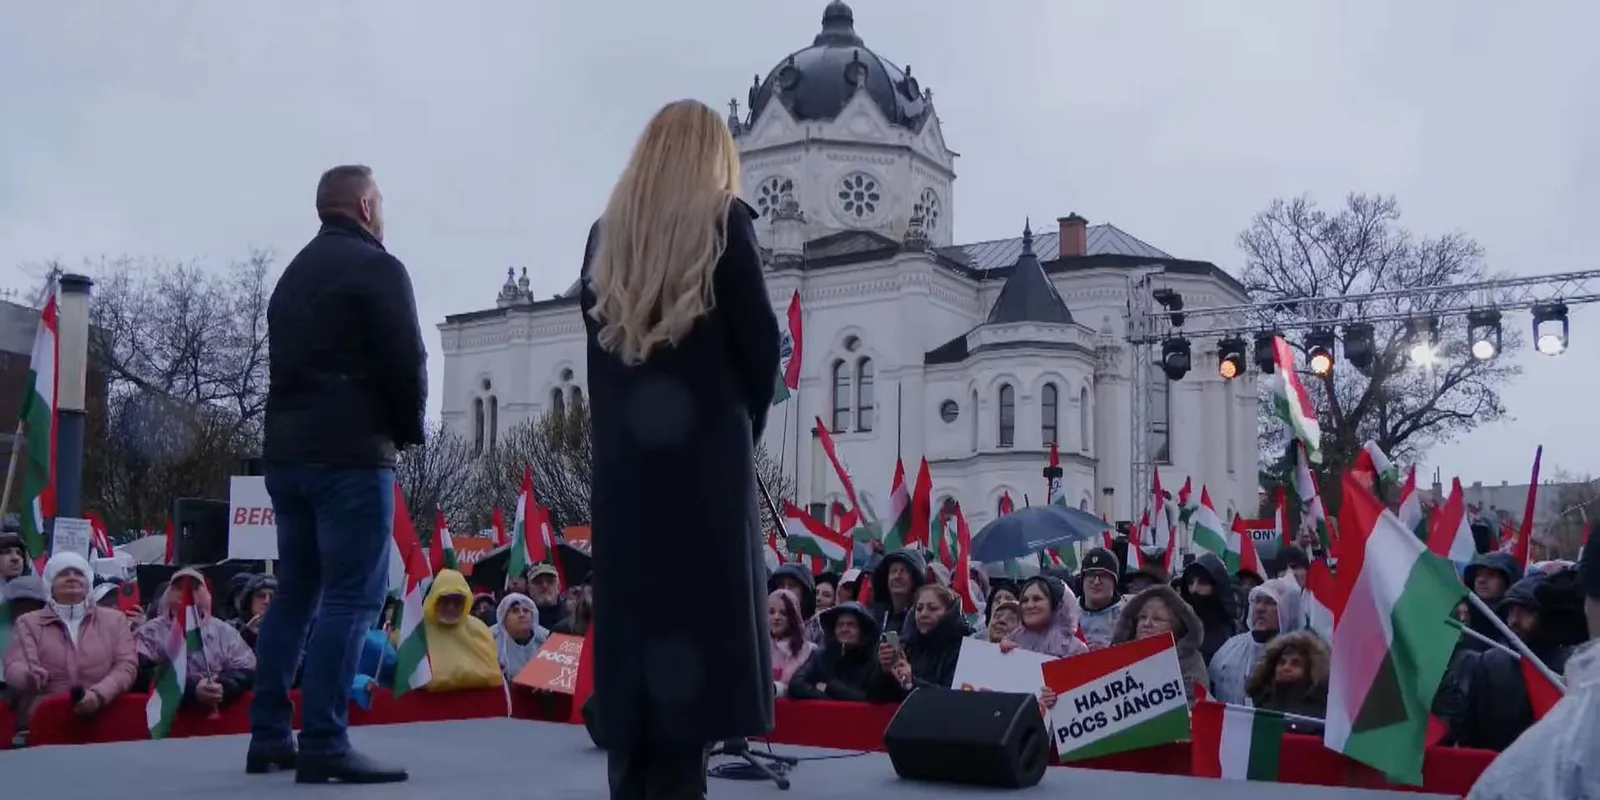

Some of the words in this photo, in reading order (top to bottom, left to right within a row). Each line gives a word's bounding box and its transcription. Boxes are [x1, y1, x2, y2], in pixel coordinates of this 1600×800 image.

[233, 507, 276, 526] BER
[1057, 716, 1108, 744] PÓCS
[1112, 679, 1183, 722] JÁNOS!
[1073, 670, 1145, 714] HAJRÁ,
